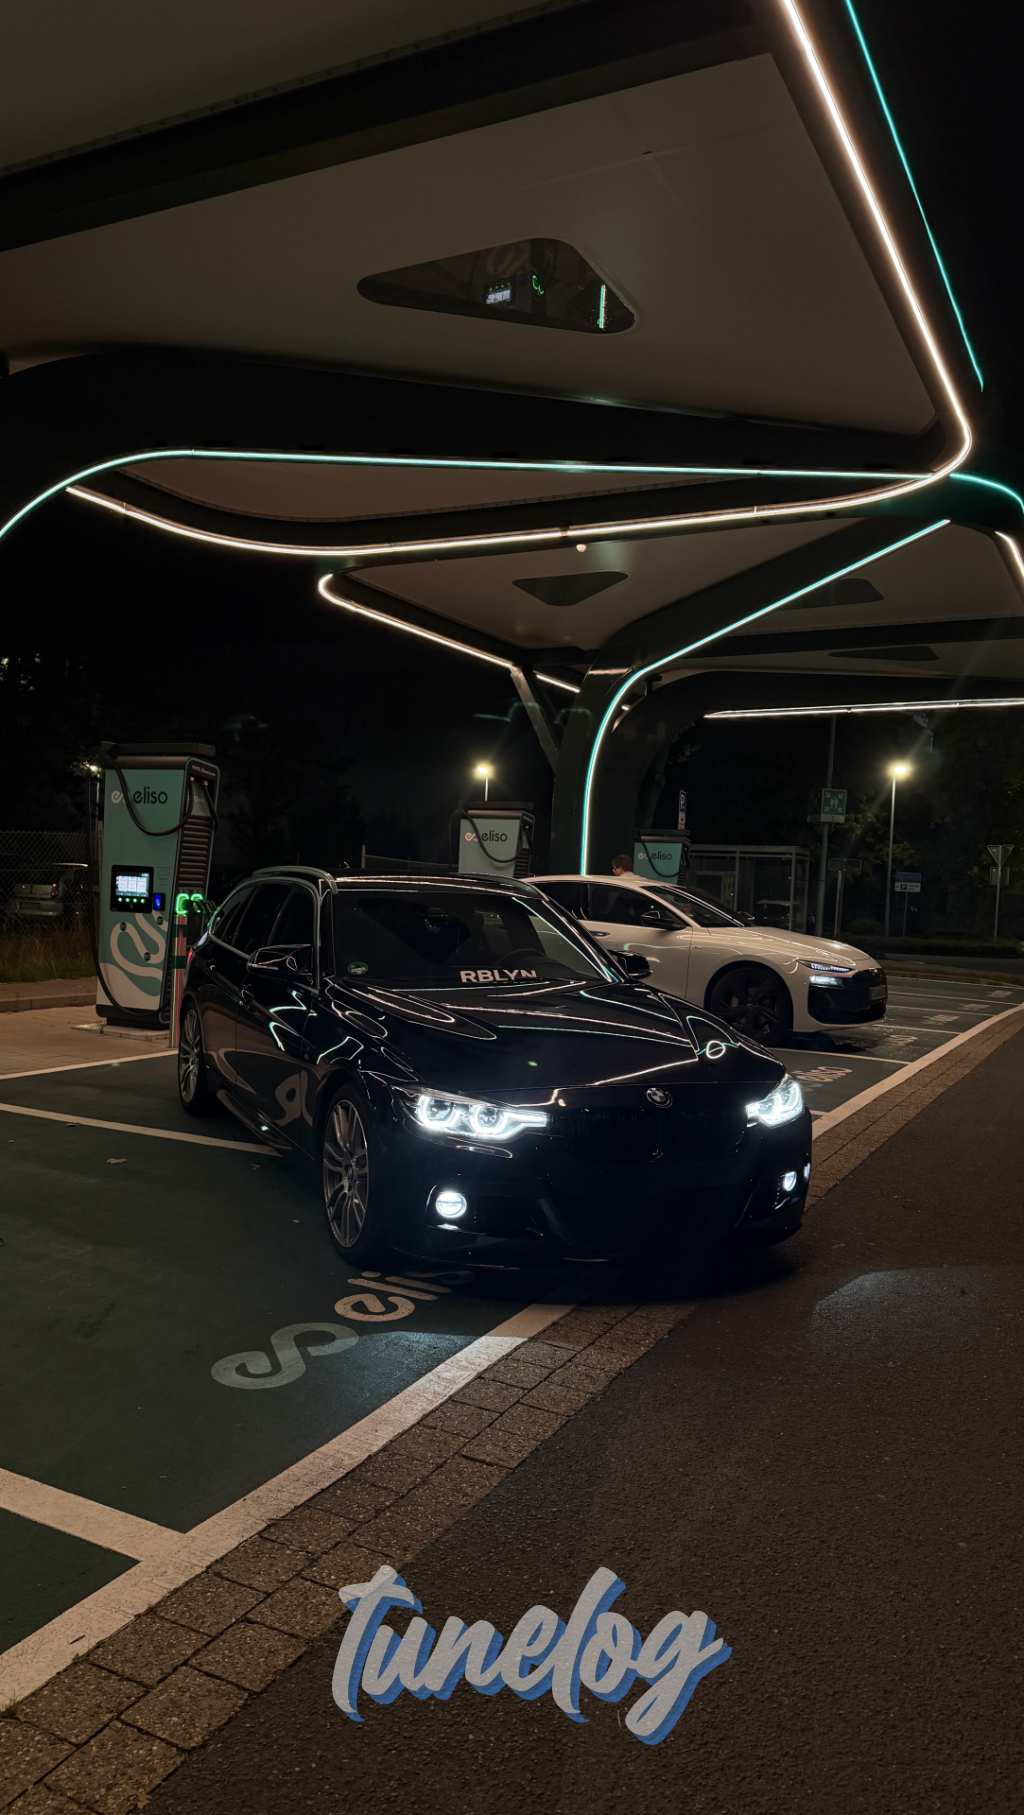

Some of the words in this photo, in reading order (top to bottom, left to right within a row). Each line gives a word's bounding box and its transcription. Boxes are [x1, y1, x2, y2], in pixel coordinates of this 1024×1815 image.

[133, 786, 168, 805] eliso
[481, 829, 508, 842] eliso
[459, 967, 537, 984] RBLYN
